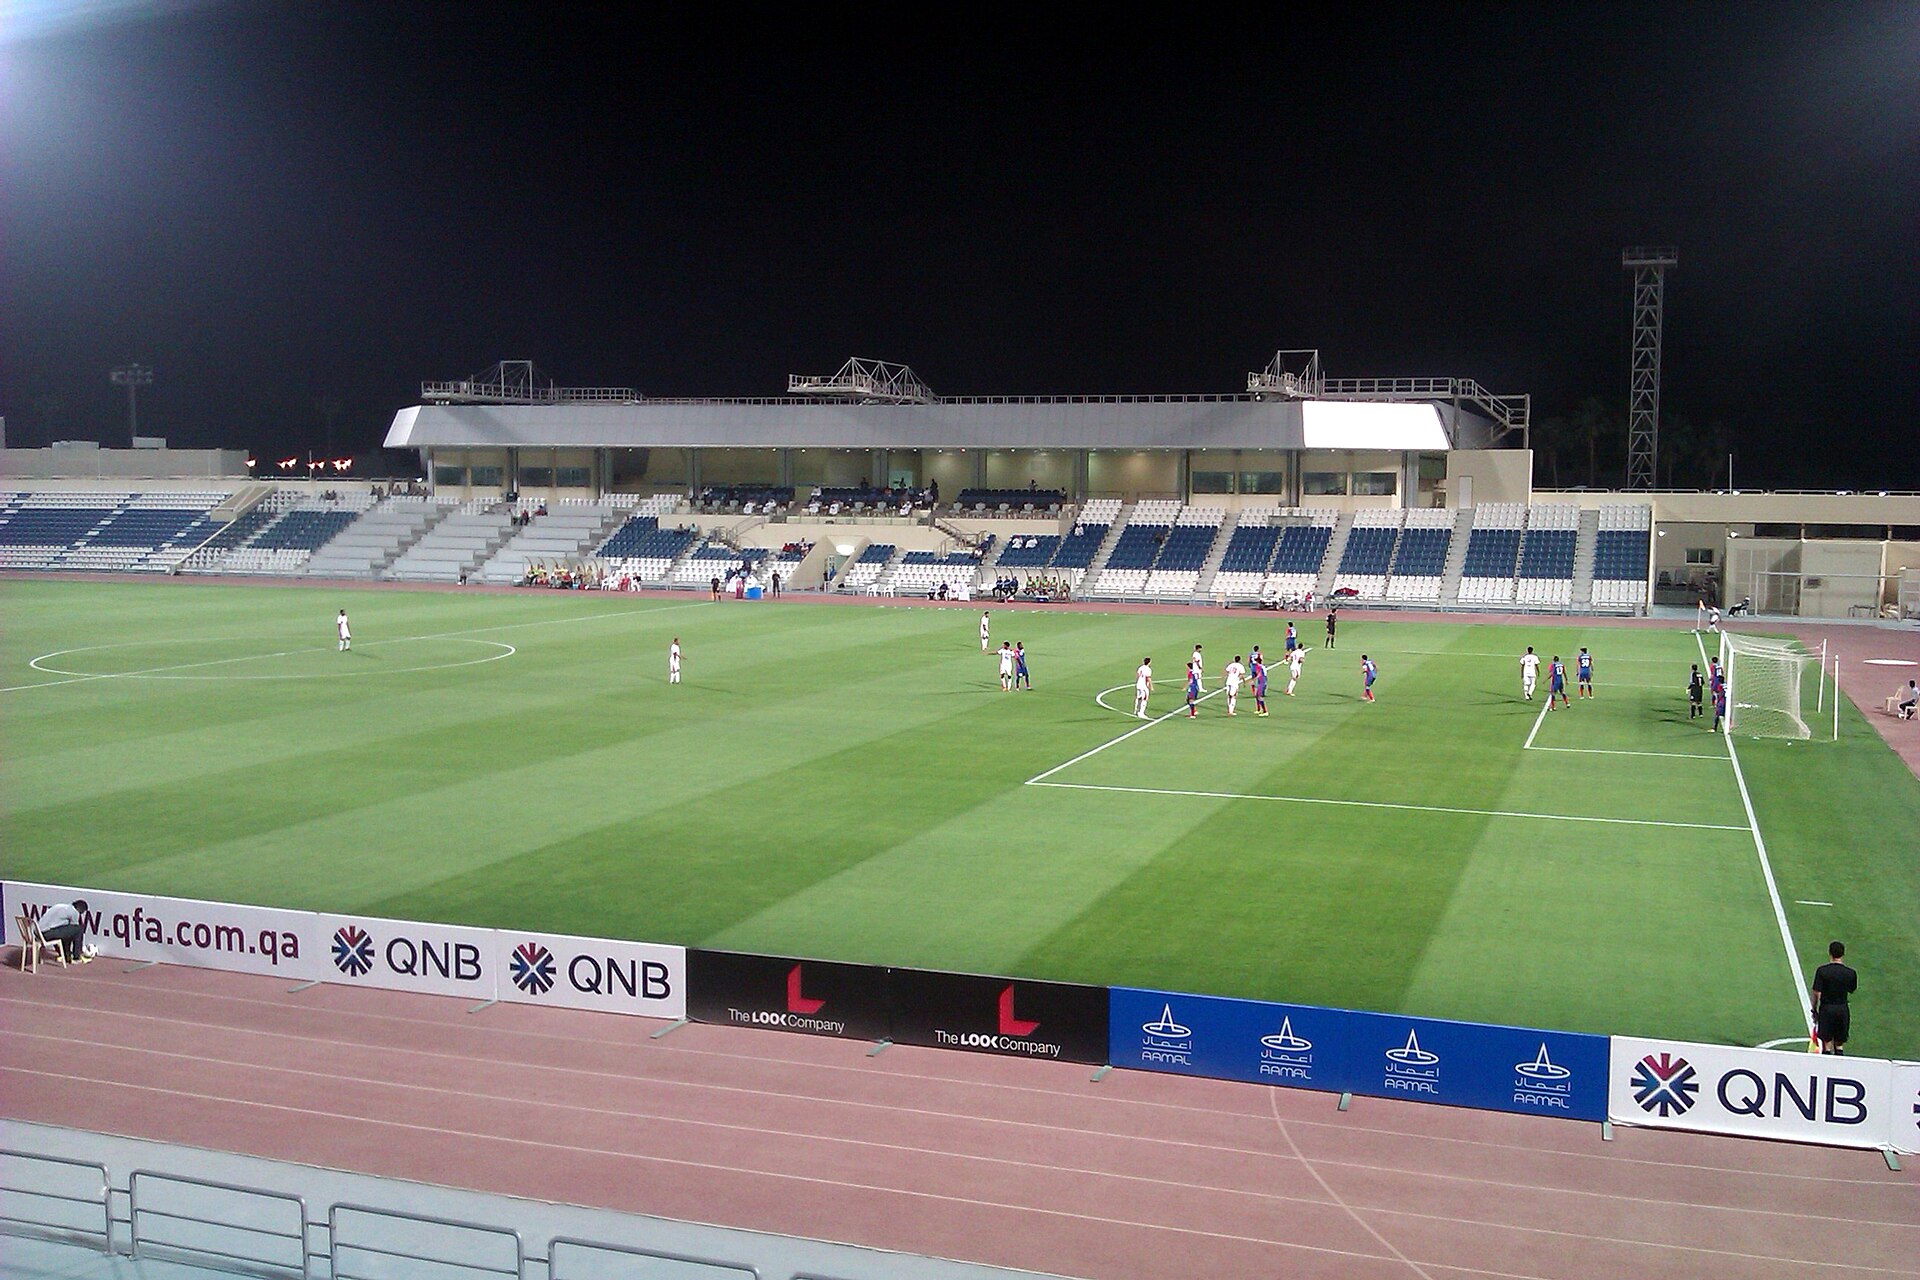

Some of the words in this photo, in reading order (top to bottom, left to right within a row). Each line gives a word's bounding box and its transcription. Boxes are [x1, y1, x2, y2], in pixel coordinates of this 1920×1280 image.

[21, 902, 300, 965] ww.qfa.com.qa
[385, 936, 482, 981] QNB
[568, 954, 670, 1000] QNB
[728, 1008, 750, 1022] The
[787, 1014, 845, 1034] Company
[934, 1029, 959, 1044] The
[998, 1036, 1061, 1057] Company
[1142, 1052, 1192, 1066] AAMAL
[1260, 1065, 1313, 1080] AAMAL
[1385, 1078, 1440, 1094] AAMAL
[1717, 1069, 1868, 1124] QNB
[1514, 1093, 1571, 1109] AAMAL
